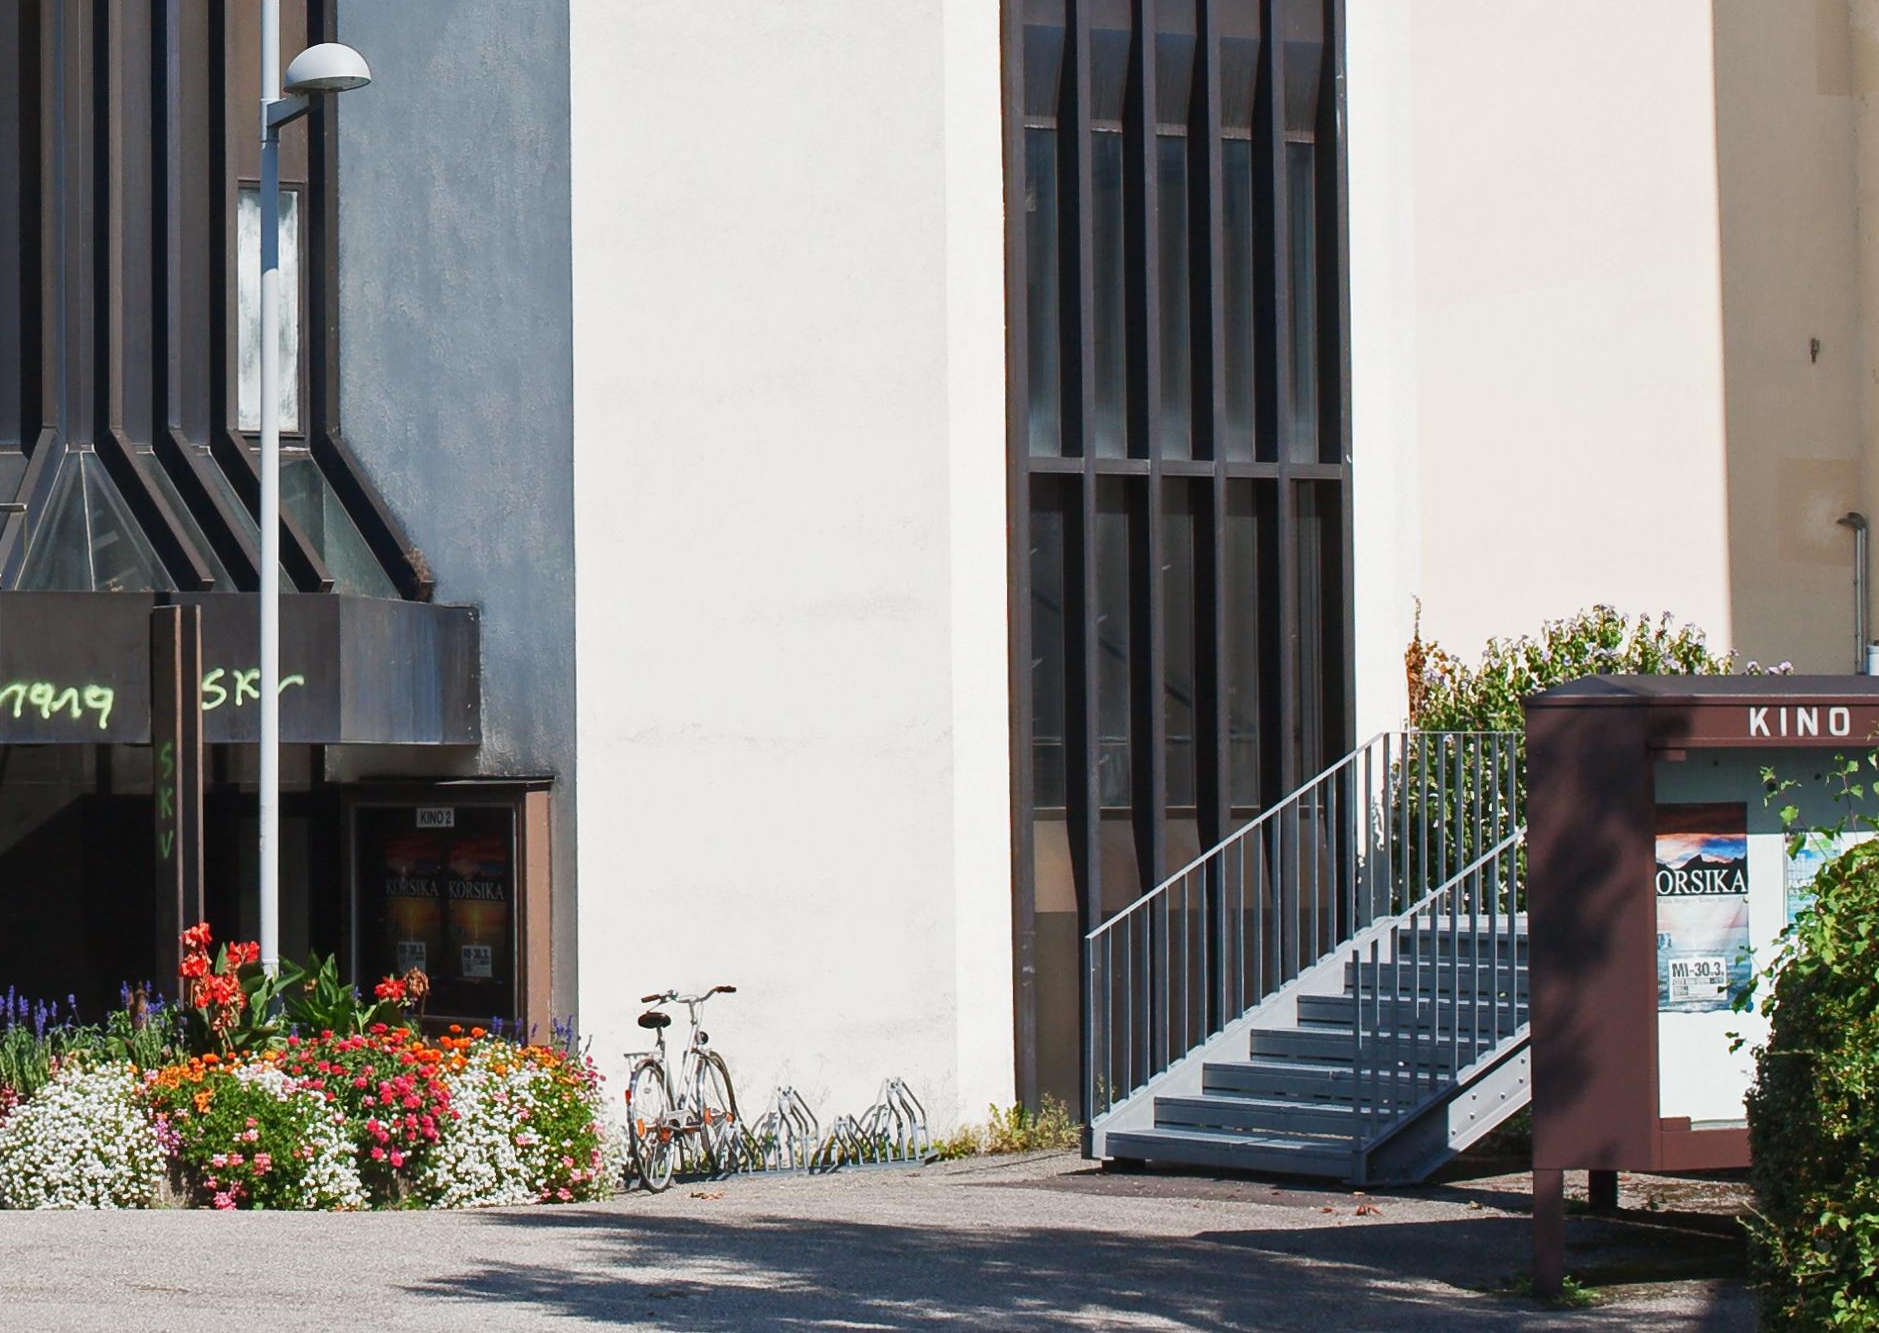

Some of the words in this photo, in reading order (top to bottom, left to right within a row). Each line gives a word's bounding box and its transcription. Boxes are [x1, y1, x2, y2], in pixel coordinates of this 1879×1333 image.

[1748, 706, 1851, 737] KINO
[420, 811, 444, 824] KINO
[445, 811, 452, 824] 2
[386, 878, 438, 896] KORSIKA
[449, 881, 504, 900] KORSIKA
[1656, 869, 1748, 894] ORSIKA
[1671, 962, 1725, 978] MI-30.3.
